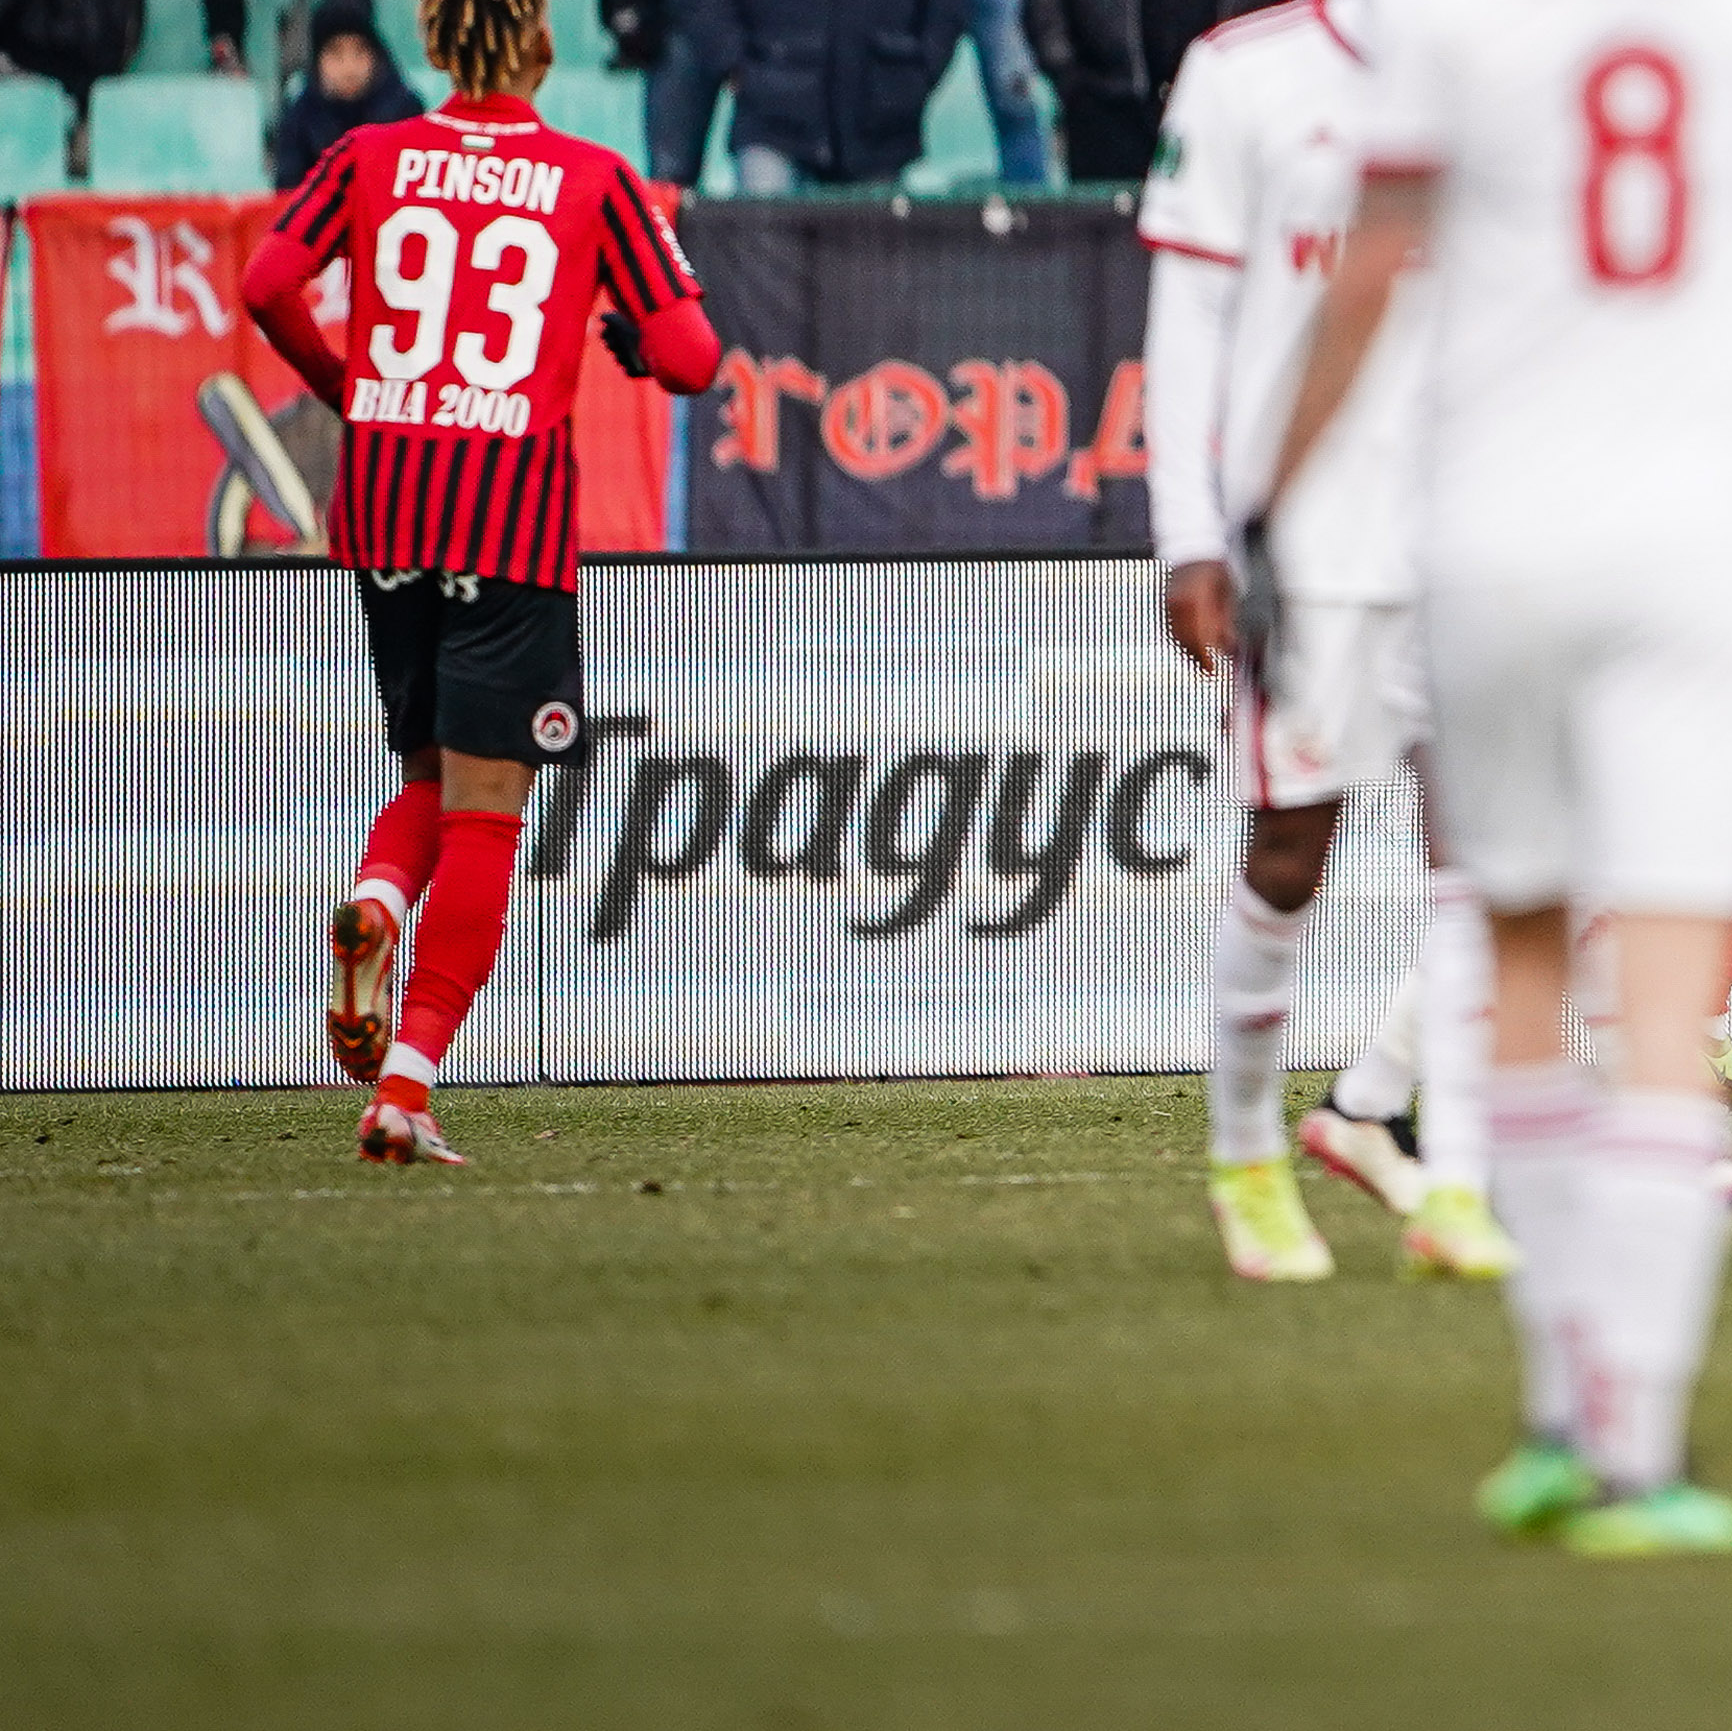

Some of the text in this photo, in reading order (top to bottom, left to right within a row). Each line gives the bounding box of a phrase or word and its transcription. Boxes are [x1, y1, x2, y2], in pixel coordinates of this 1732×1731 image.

[392, 148, 564, 215] PINSON
[1580, 42, 1690, 292] 8
[369, 205, 559, 391] 93
[431, 383, 531, 438] 2000
